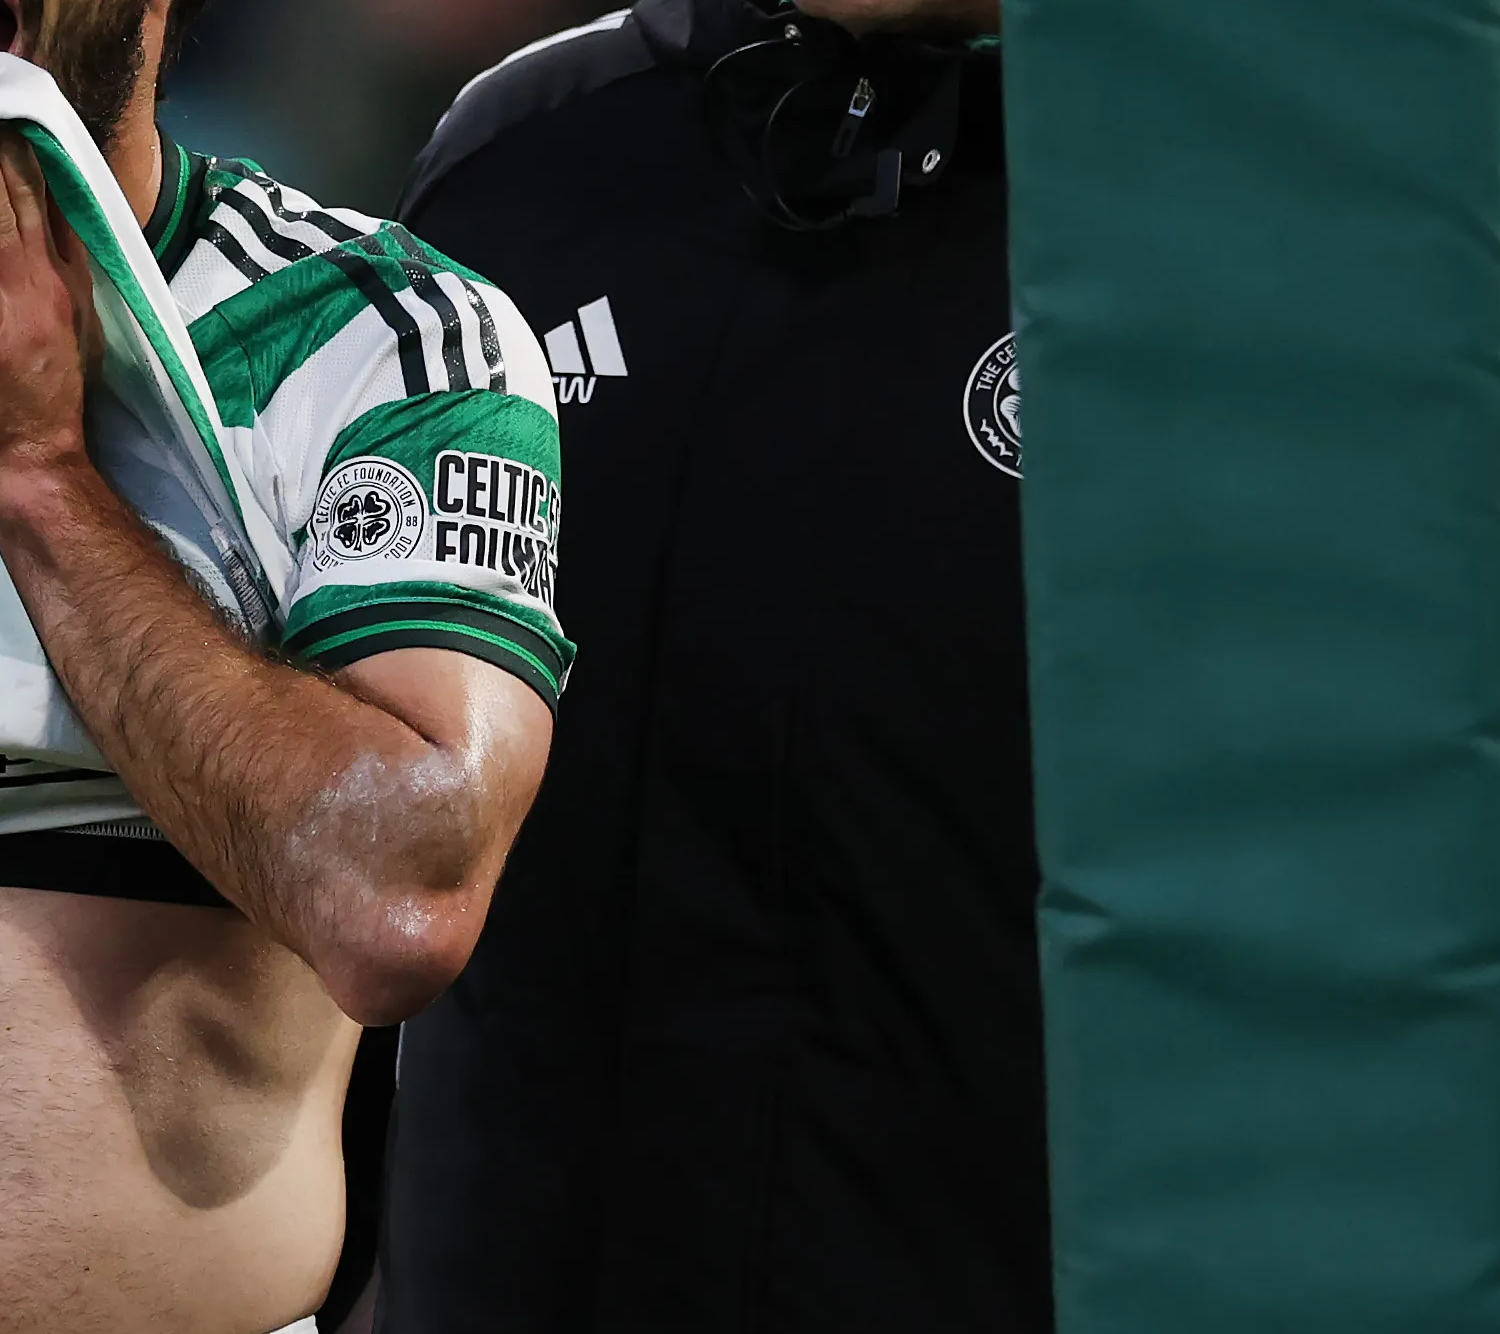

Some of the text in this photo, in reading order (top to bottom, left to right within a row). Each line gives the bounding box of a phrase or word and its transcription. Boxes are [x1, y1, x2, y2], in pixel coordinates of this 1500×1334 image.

[975, 360, 1002, 392] THE
[316, 467, 416, 524] CELTIC FC FOUNDATION
[437, 454, 545, 533] CELTIC
[405, 516, 418, 527] 88
